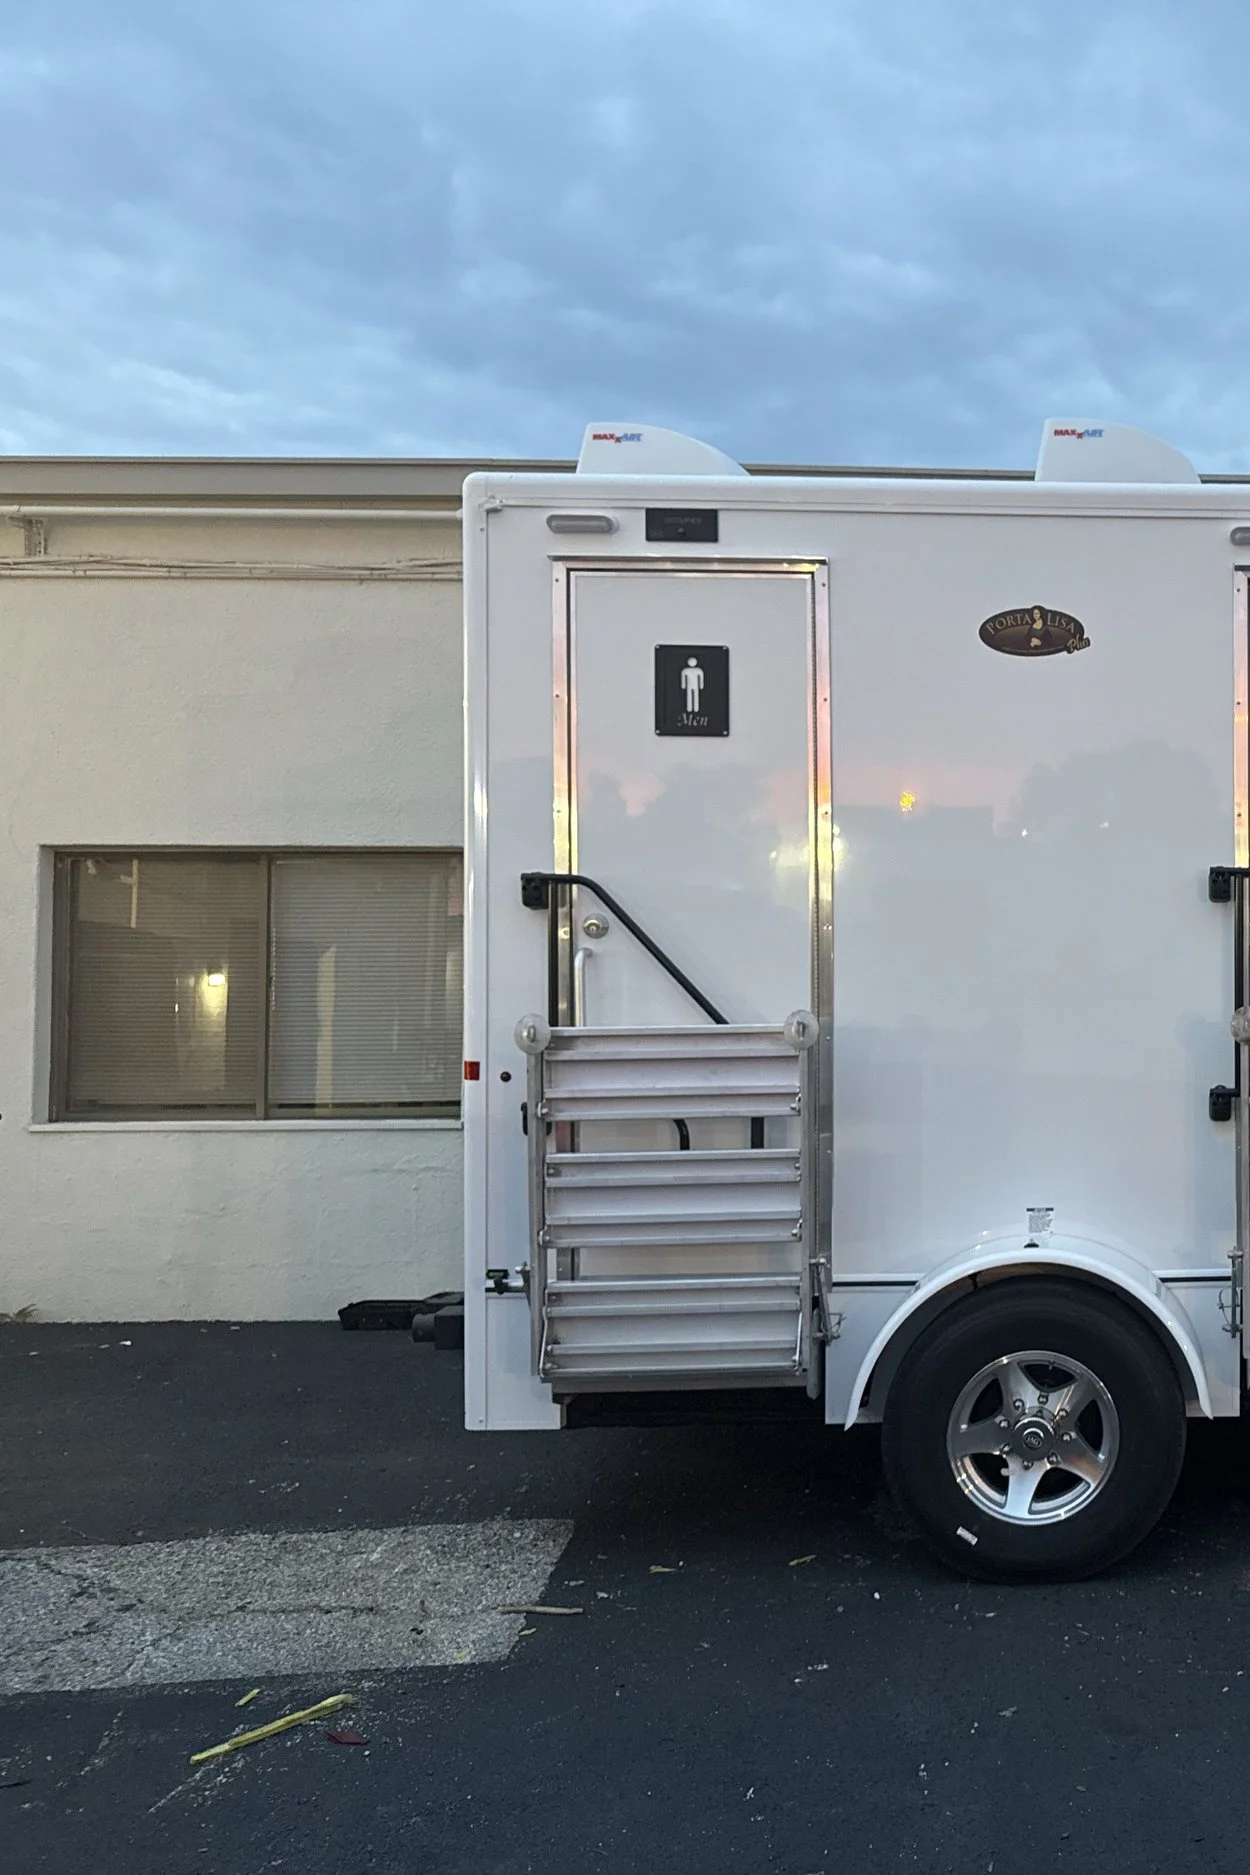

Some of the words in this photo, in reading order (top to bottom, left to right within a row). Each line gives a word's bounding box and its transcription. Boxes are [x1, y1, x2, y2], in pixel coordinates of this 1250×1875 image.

[985, 613, 1032, 635] PORTA
[1047, 612, 1075, 633] LISA
[1067, 634, 1090, 652] Plus
[677, 712, 708, 726] Men
